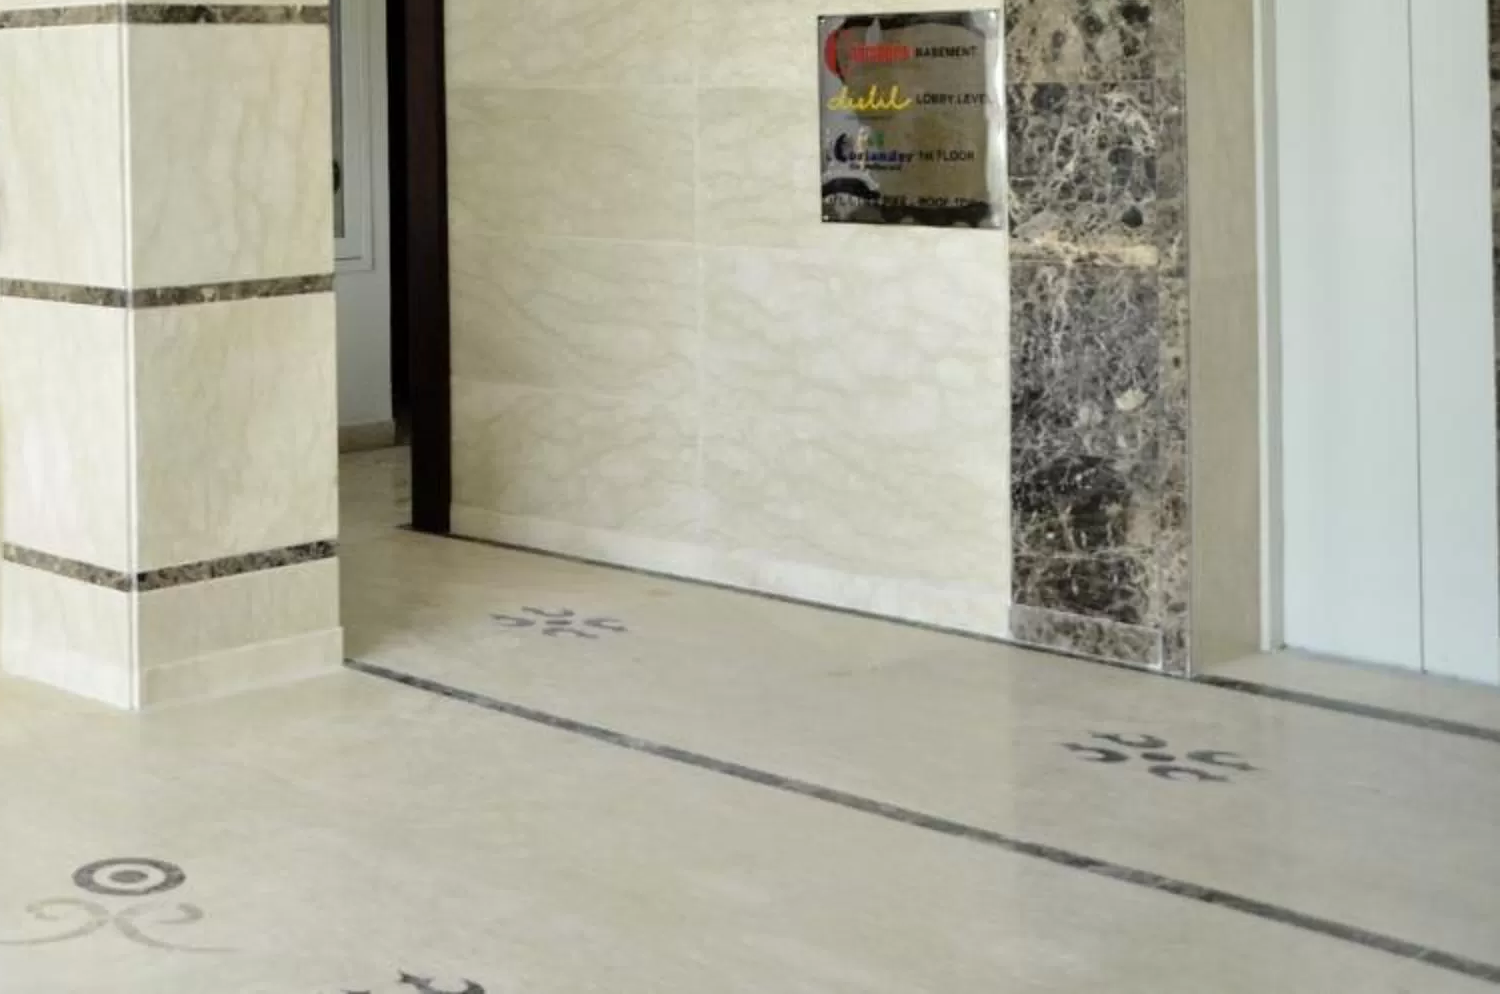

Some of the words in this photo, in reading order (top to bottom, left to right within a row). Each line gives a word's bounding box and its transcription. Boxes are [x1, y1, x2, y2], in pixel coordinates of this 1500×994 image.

[915, 45, 978, 59] BASEMENT
[915, 93, 953, 105] LOBBY
[936, 149, 975, 162] FLOOR
